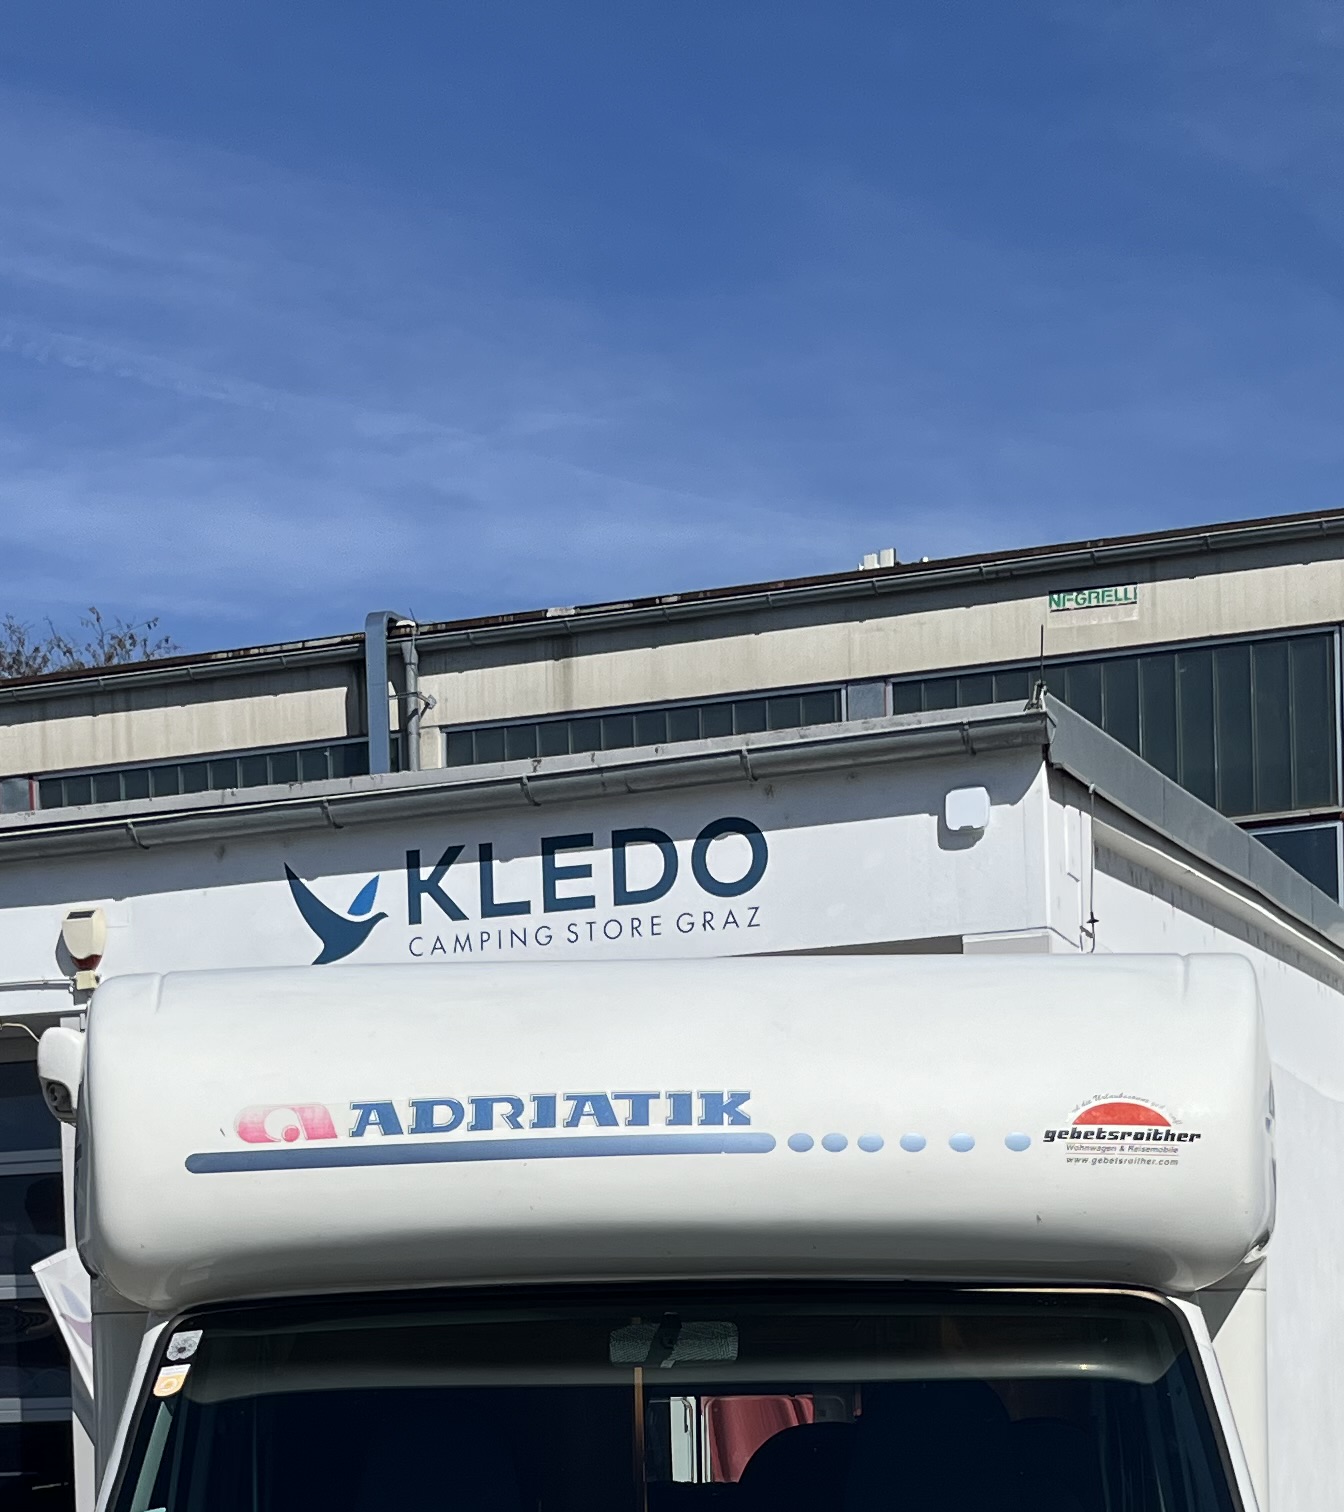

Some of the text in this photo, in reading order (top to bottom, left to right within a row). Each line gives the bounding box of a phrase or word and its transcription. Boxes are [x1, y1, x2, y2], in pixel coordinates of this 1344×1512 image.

[406, 816, 768, 925] KLEDO
[408, 906, 762, 958] CAMPING STORE GRAZ
[349, 1090, 752, 1138] ADRIATIK
[1043, 1127, 1201, 1143] gebetsroither
[1066, 1144, 1116, 1153] Wohnwagen
[1128, 1145, 1178, 1154] Reisemobile
[1066, 1157, 1178, 1166] www.gebetsroither.com
